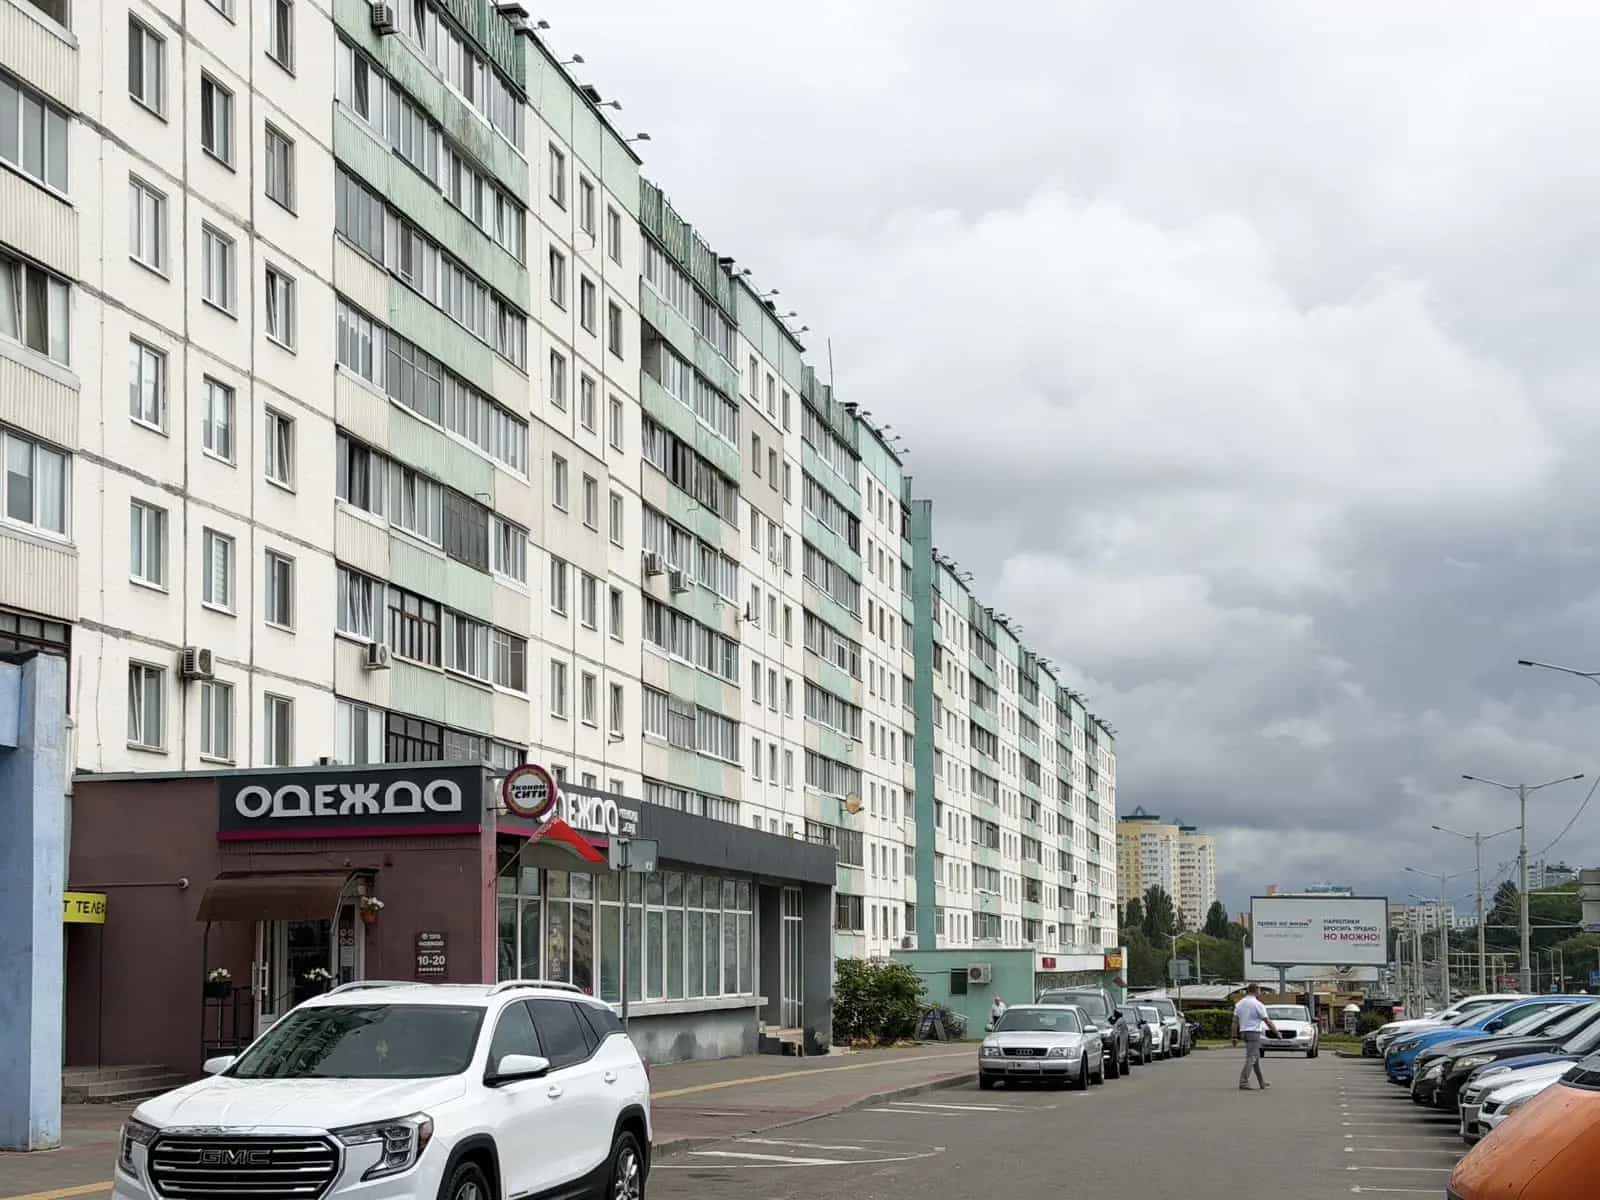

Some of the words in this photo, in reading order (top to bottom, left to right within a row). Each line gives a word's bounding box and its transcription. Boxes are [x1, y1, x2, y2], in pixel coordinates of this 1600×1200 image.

[235, 778, 463, 819] ОДЕЖДА
[514, 790, 547, 799] СИТИ
[1323, 933, 1338, 941] НО
[417, 955, 446, 966] 10-20
[200, 1149, 271, 1165] GMC
